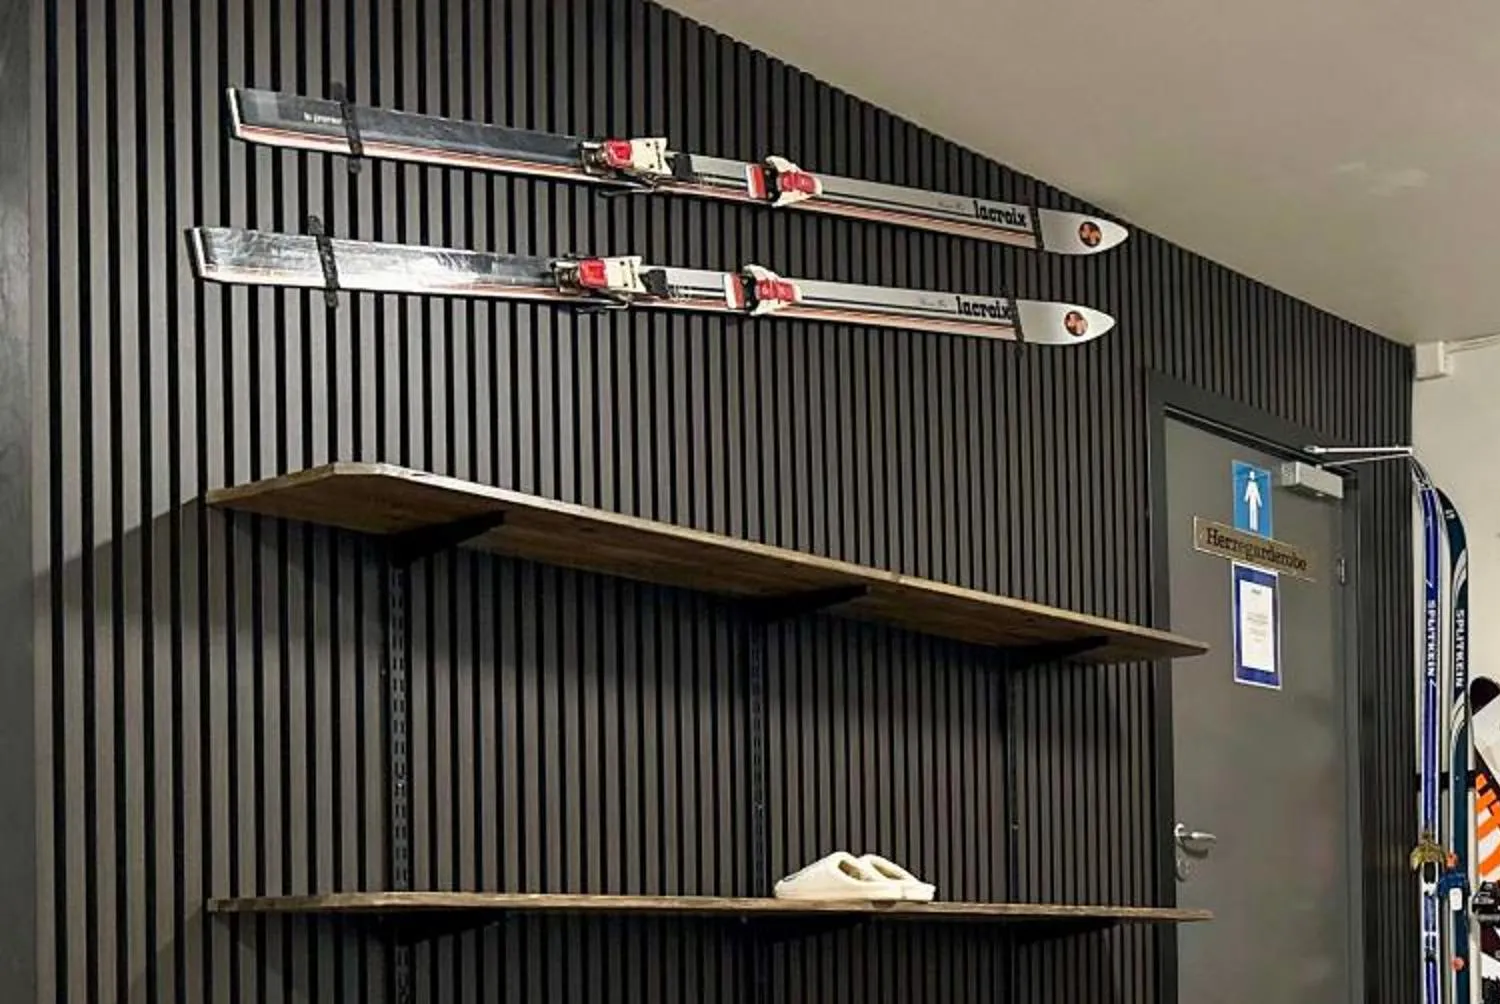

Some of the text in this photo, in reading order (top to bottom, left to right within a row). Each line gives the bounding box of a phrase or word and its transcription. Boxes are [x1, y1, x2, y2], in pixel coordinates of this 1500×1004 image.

[973, 200, 1027, 228] lacroix
[956, 296, 1012, 320] lacroix
[1427, 599, 1438, 678] SPLITKEIN
[1454, 609, 1466, 689] SPLITKEIN
